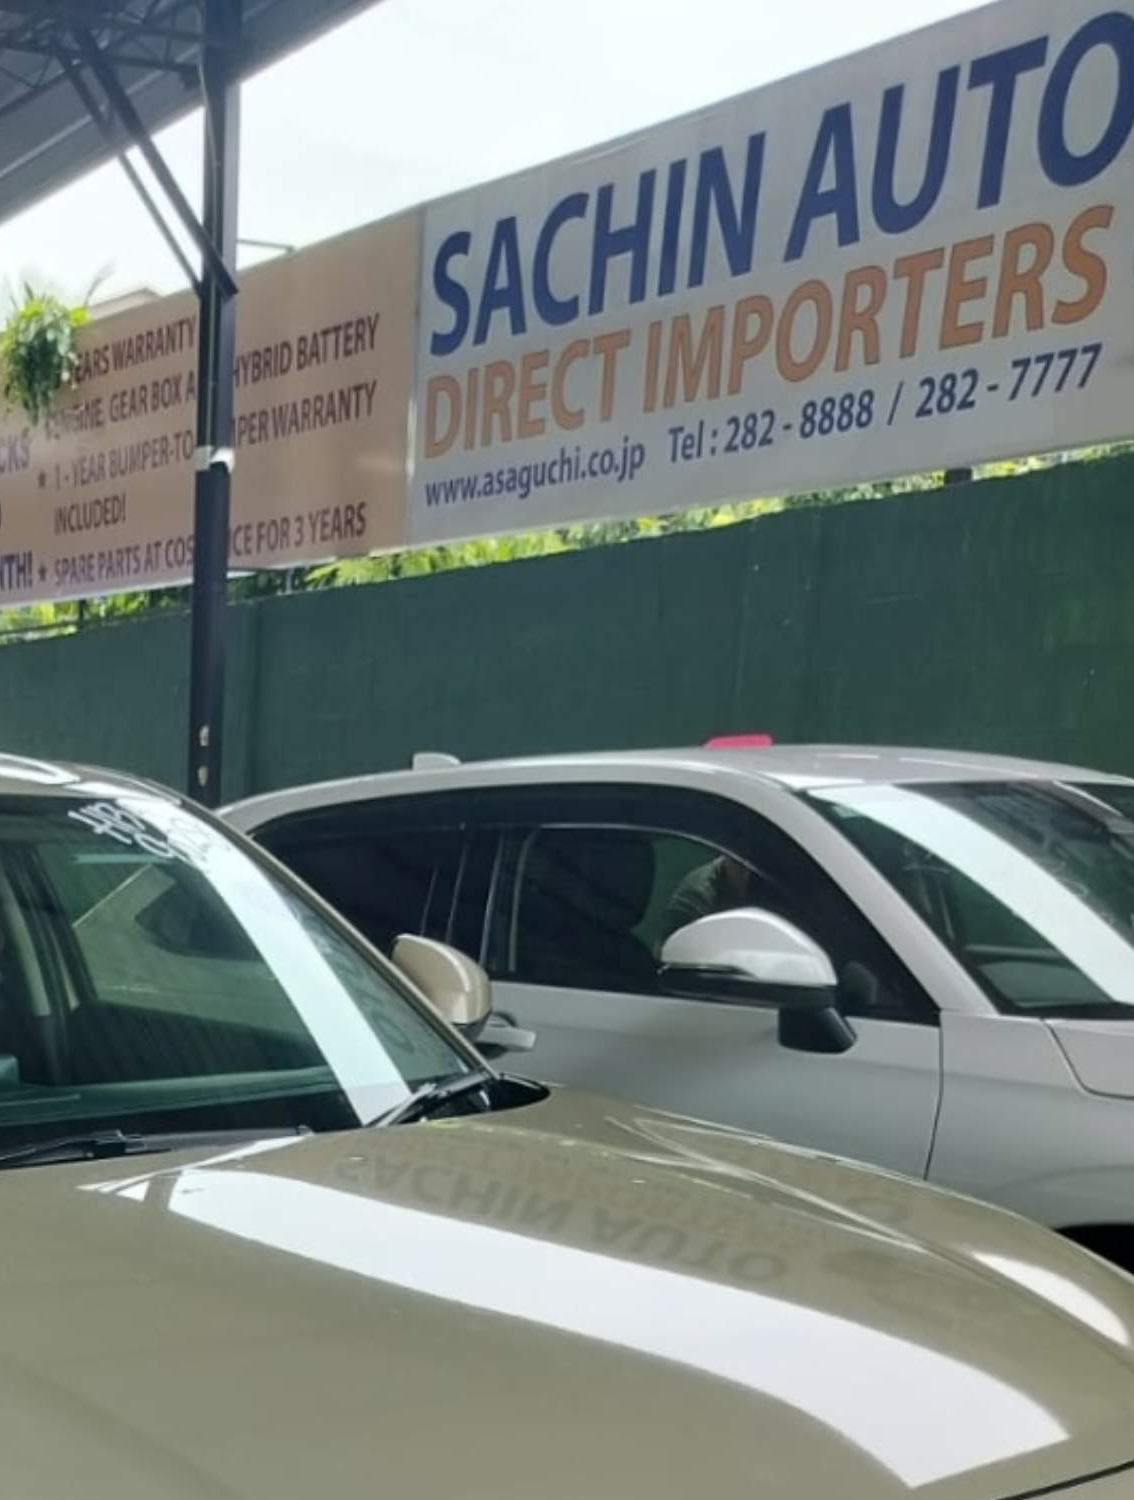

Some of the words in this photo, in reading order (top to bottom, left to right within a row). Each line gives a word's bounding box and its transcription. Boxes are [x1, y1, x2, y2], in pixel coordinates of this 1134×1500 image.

[429, 131, 766, 356] SACHIN
[783, 11, 1134, 262] AUTO
[73, 345, 110, 384] EARS
[113, 314, 196, 372] WARRANTY
[296, 311, 381, 372] BATTERY
[423, 329, 631, 459] DIRECT
[642, 204, 1115, 415] IMPORTERS
[109, 385, 149, 423] GEAR
[151, 372, 182, 412] BOX
[271, 379, 378, 440] WARRANTY
[424, 435, 646, 507] www.asaguchi.co.jp
[53, 493, 127, 537] INCLUDED!
[256, 516, 291, 554] FOR
[293, 514, 306, 548] 3
[308, 501, 368, 545] YEARS
[53, 551, 96, 587] SPARE
[97, 545, 142, 580] PARTS
[143, 540, 163, 573] AT
[165, 533, 195, 569] COS
